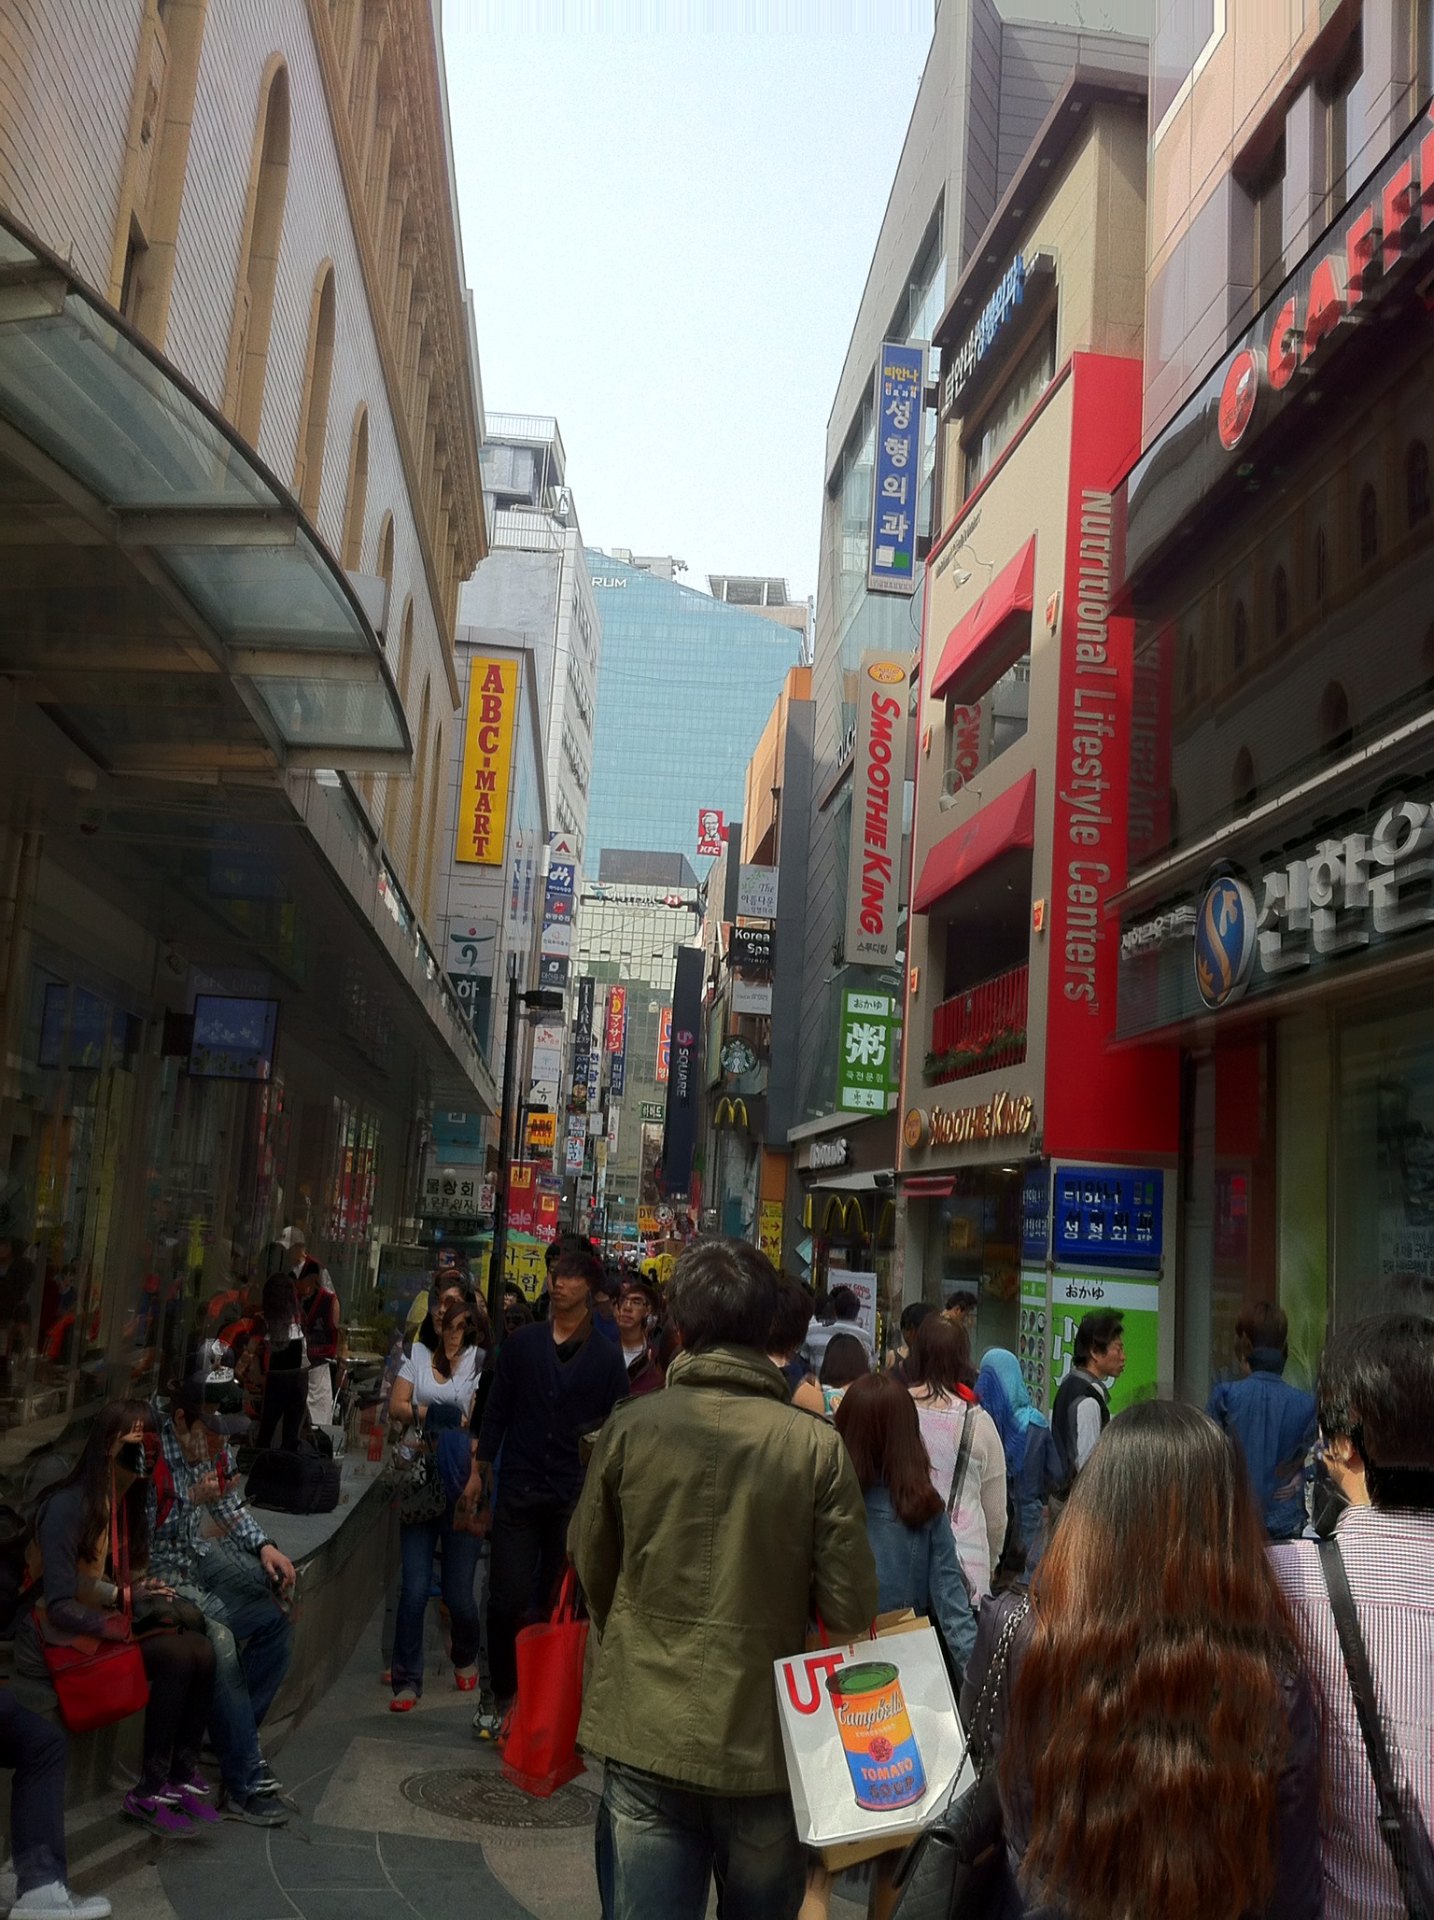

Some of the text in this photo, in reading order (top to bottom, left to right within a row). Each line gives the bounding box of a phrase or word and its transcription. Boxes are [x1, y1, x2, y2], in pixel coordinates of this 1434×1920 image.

[880, 401, 911, 543] 성형외과
[1075, 490, 1118, 676] Nutritional
[472, 664, 504, 857] ABC-MART
[864, 691, 900, 850] SMOOTHIE
[1059, 688, 1117, 846] Lifestyle
[699, 845, 720, 855] KFC
[859, 849, 892, 936] KING
[735, 929, 770, 943] Korea
[747, 943, 770, 957] Spa
[1063, 861, 1111, 1002] Centers
[853, 998, 883, 1011] おかゆ
[846, 1022, 887, 1066] 粥
[676, 1048, 689, 1098] SQUARE
[536, 1223, 557, 1238] Sale
[1065, 1284, 1105, 1301] おかゆ
[783, 1652, 845, 1715] UT
[861, 1757, 914, 1782] TOMATO
[869, 1776, 915, 1799] SOUP
